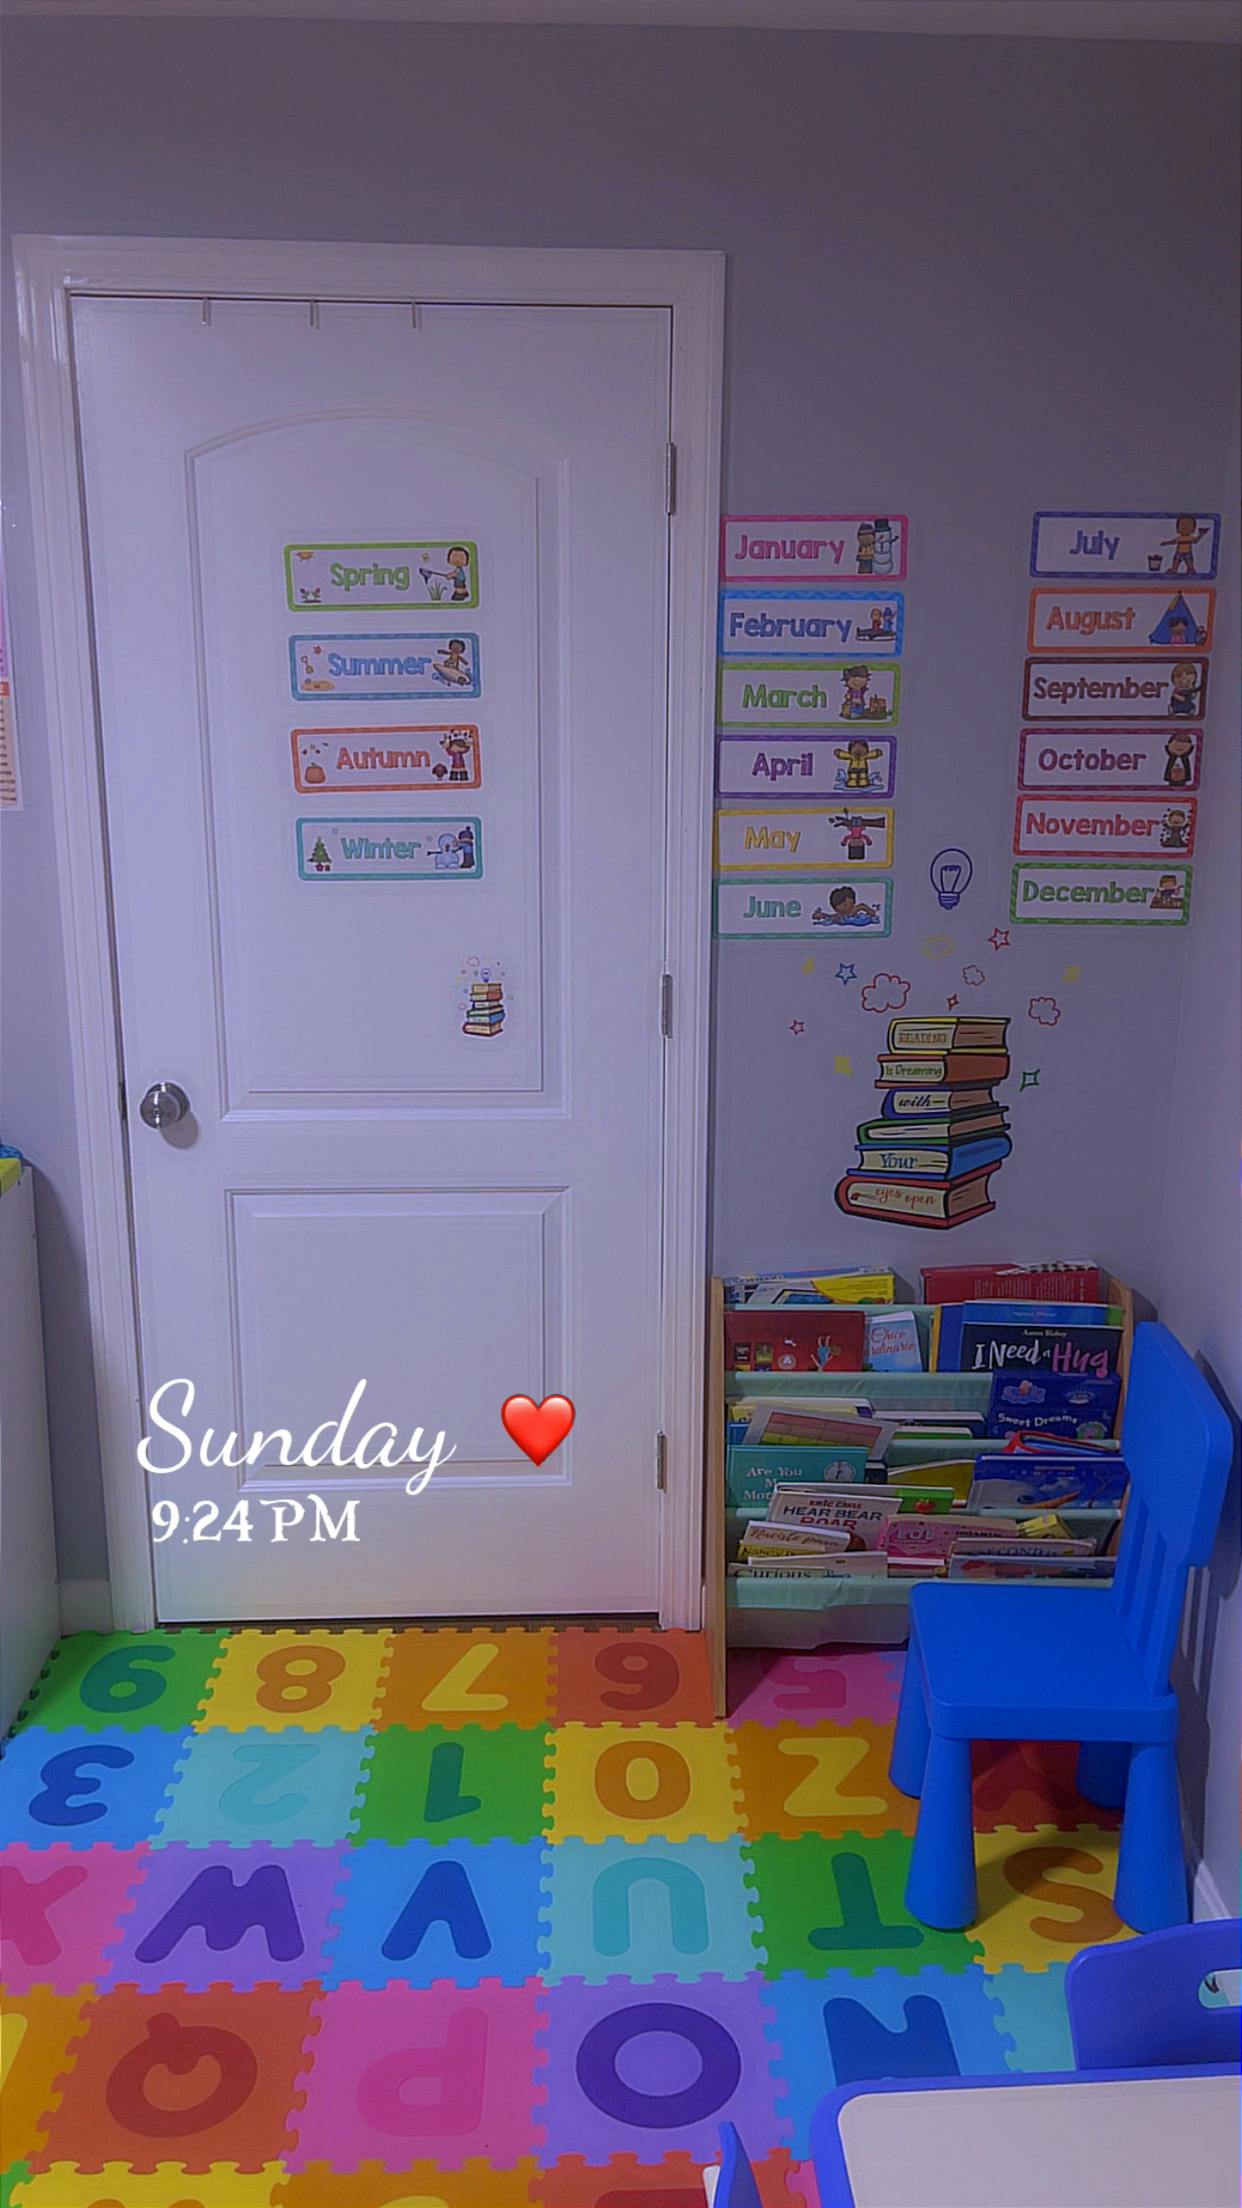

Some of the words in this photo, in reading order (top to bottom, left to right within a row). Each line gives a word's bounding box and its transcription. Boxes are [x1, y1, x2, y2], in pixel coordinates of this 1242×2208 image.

[734, 534, 845, 565] January
[1069, 529, 1120, 560] July
[329, 562, 410, 592] Spring
[729, 612, 852, 643] February
[1046, 606, 1136, 636] August
[327, 653, 432, 676] Summer
[742, 684, 827, 709] March
[1033, 676, 1169, 705] September
[336, 747, 431, 770] Autumn
[752, 752, 814, 781] April
[1038, 748, 1147, 772] October
[1026, 812, 1160, 837] November
[341, 837, 422, 860] Winter
[744, 826, 801, 854] May
[1022, 880, 1154, 904] December
[743, 896, 801, 919] June
[886, 1065, 896, 1076] Is
[897, 1064, 942, 1078] Dreaming
[898, 1095, 931, 1108] with
[879, 1153, 918, 1169] Your
[875, 1187, 901, 1203] eyes
[906, 1194, 936, 1210] open
[972, 1343, 987, 1370] I
[988, 1339, 1042, 1370] Need
[1042, 1350, 1051, 1359] a
[1052, 1341, 1109, 1378] Hug
[998, 1412, 1031, 1428] Sweet
[1034, 1415, 1079, 1427] Dreams
[746, 1467, 773, 1477] Are
[777, 1467, 803, 1477] You
[783, 1505, 831, 1517] HEAR
[834, 1509, 883, 1521] BEAR
[897, 1528, 936, 1541] LOL
[256, 1645, 346, 1713] 8
[421, 1644, 508, 1711] 7
[218, 1744, 321, 1826] 2
[808, 1852, 925, 1951] T
[1003, 1846, 1124, 1944] S
[105, 2012, 258, 2138] Q
